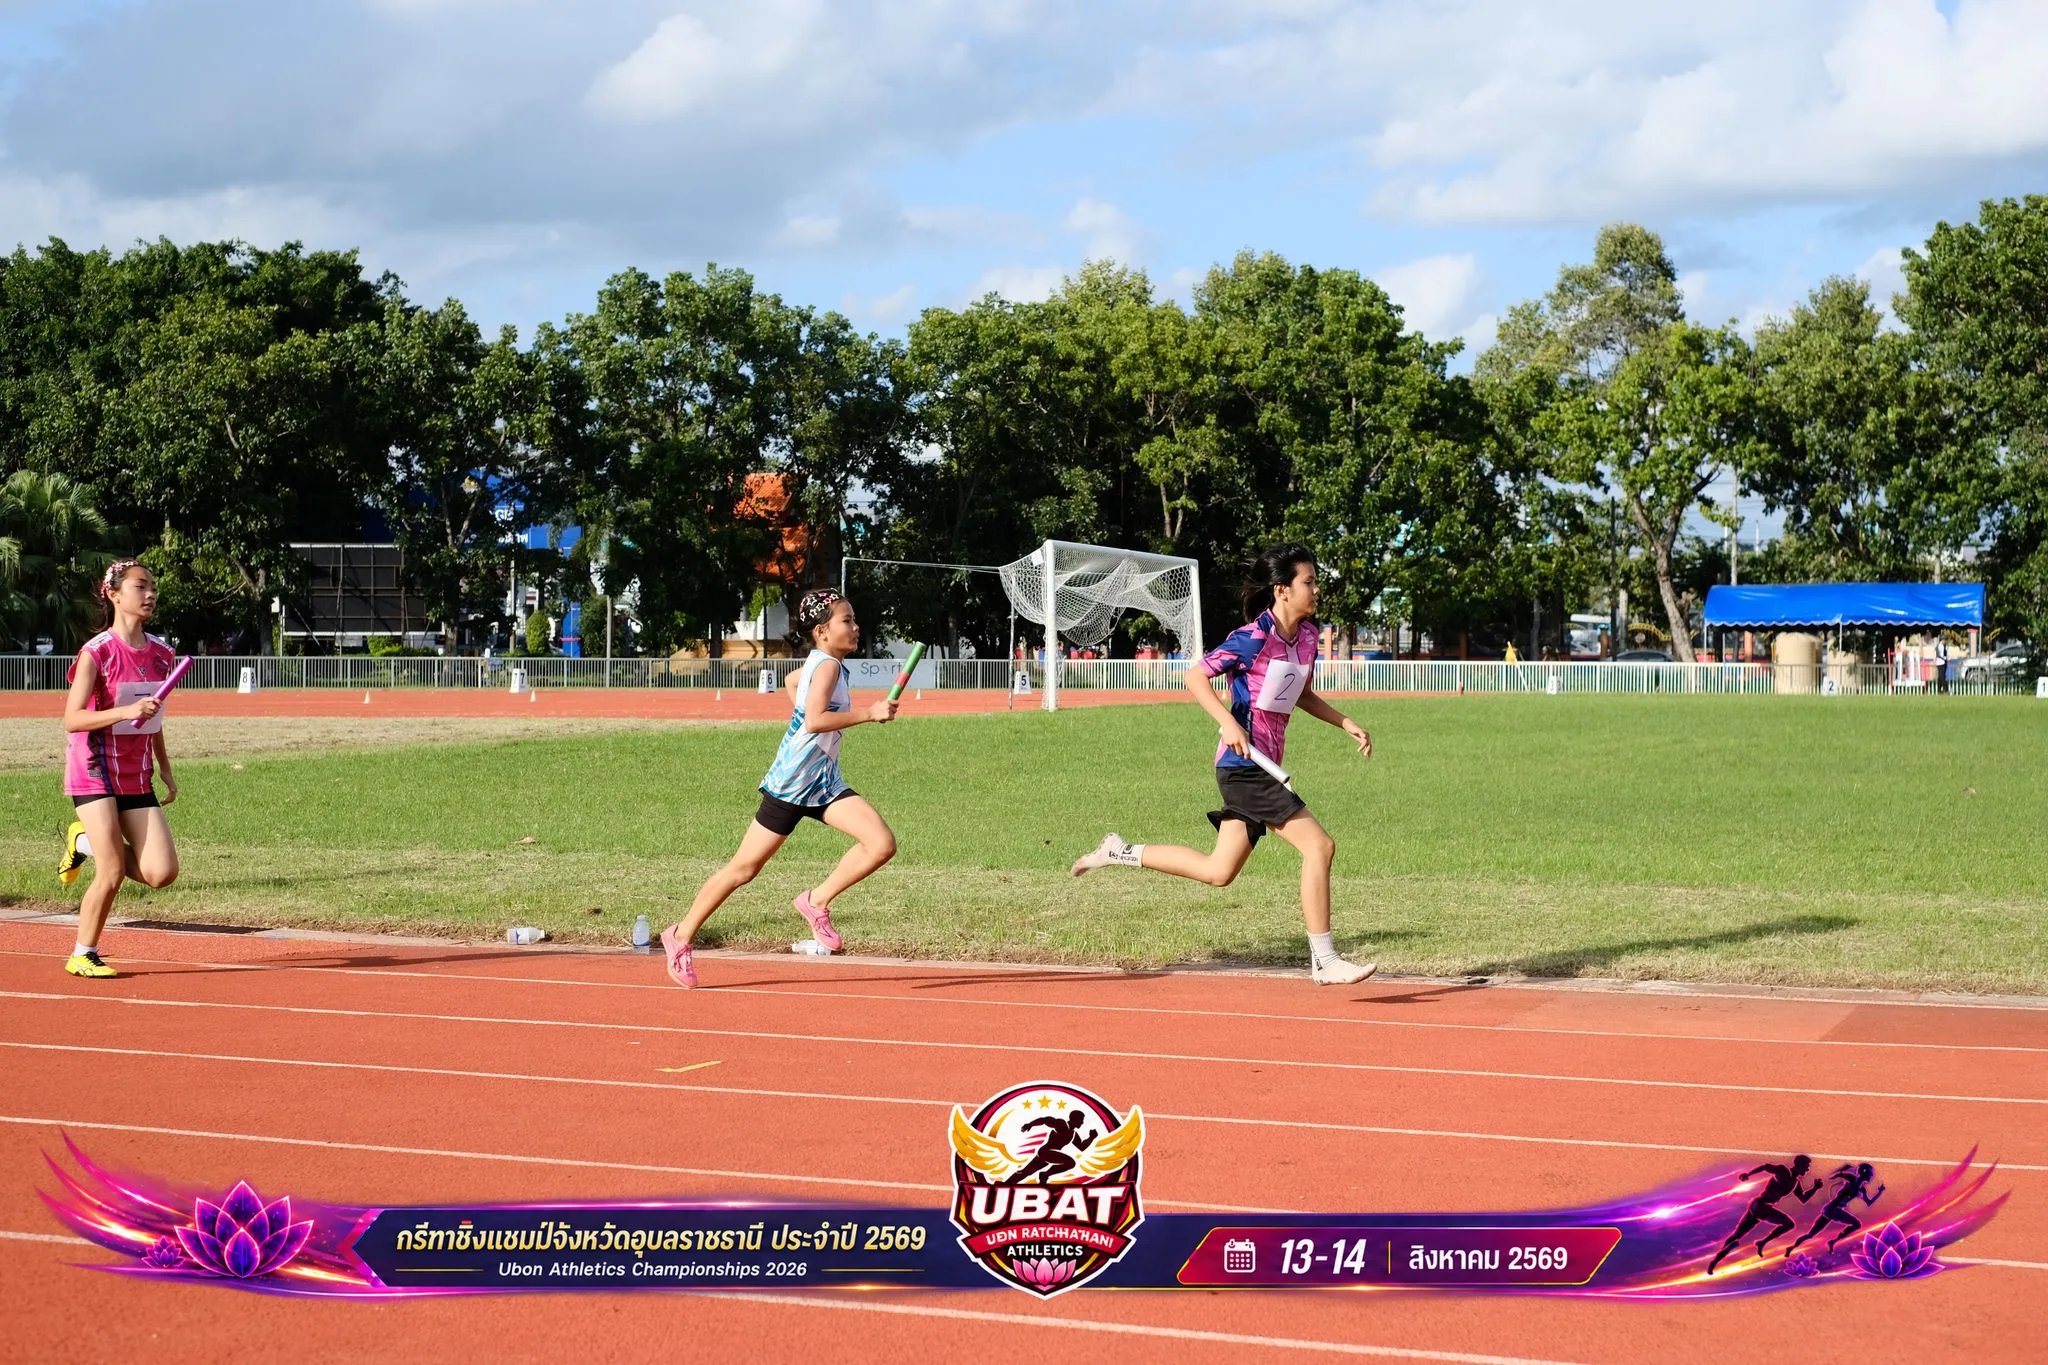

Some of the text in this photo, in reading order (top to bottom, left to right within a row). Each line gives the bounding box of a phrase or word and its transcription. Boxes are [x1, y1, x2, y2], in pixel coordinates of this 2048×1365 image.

[767, 672, 773, 685] 6
[1021, 674, 1027, 686] 5
[1274, 673, 1296, 701] 2
[1828, 680, 1835, 692] 2
